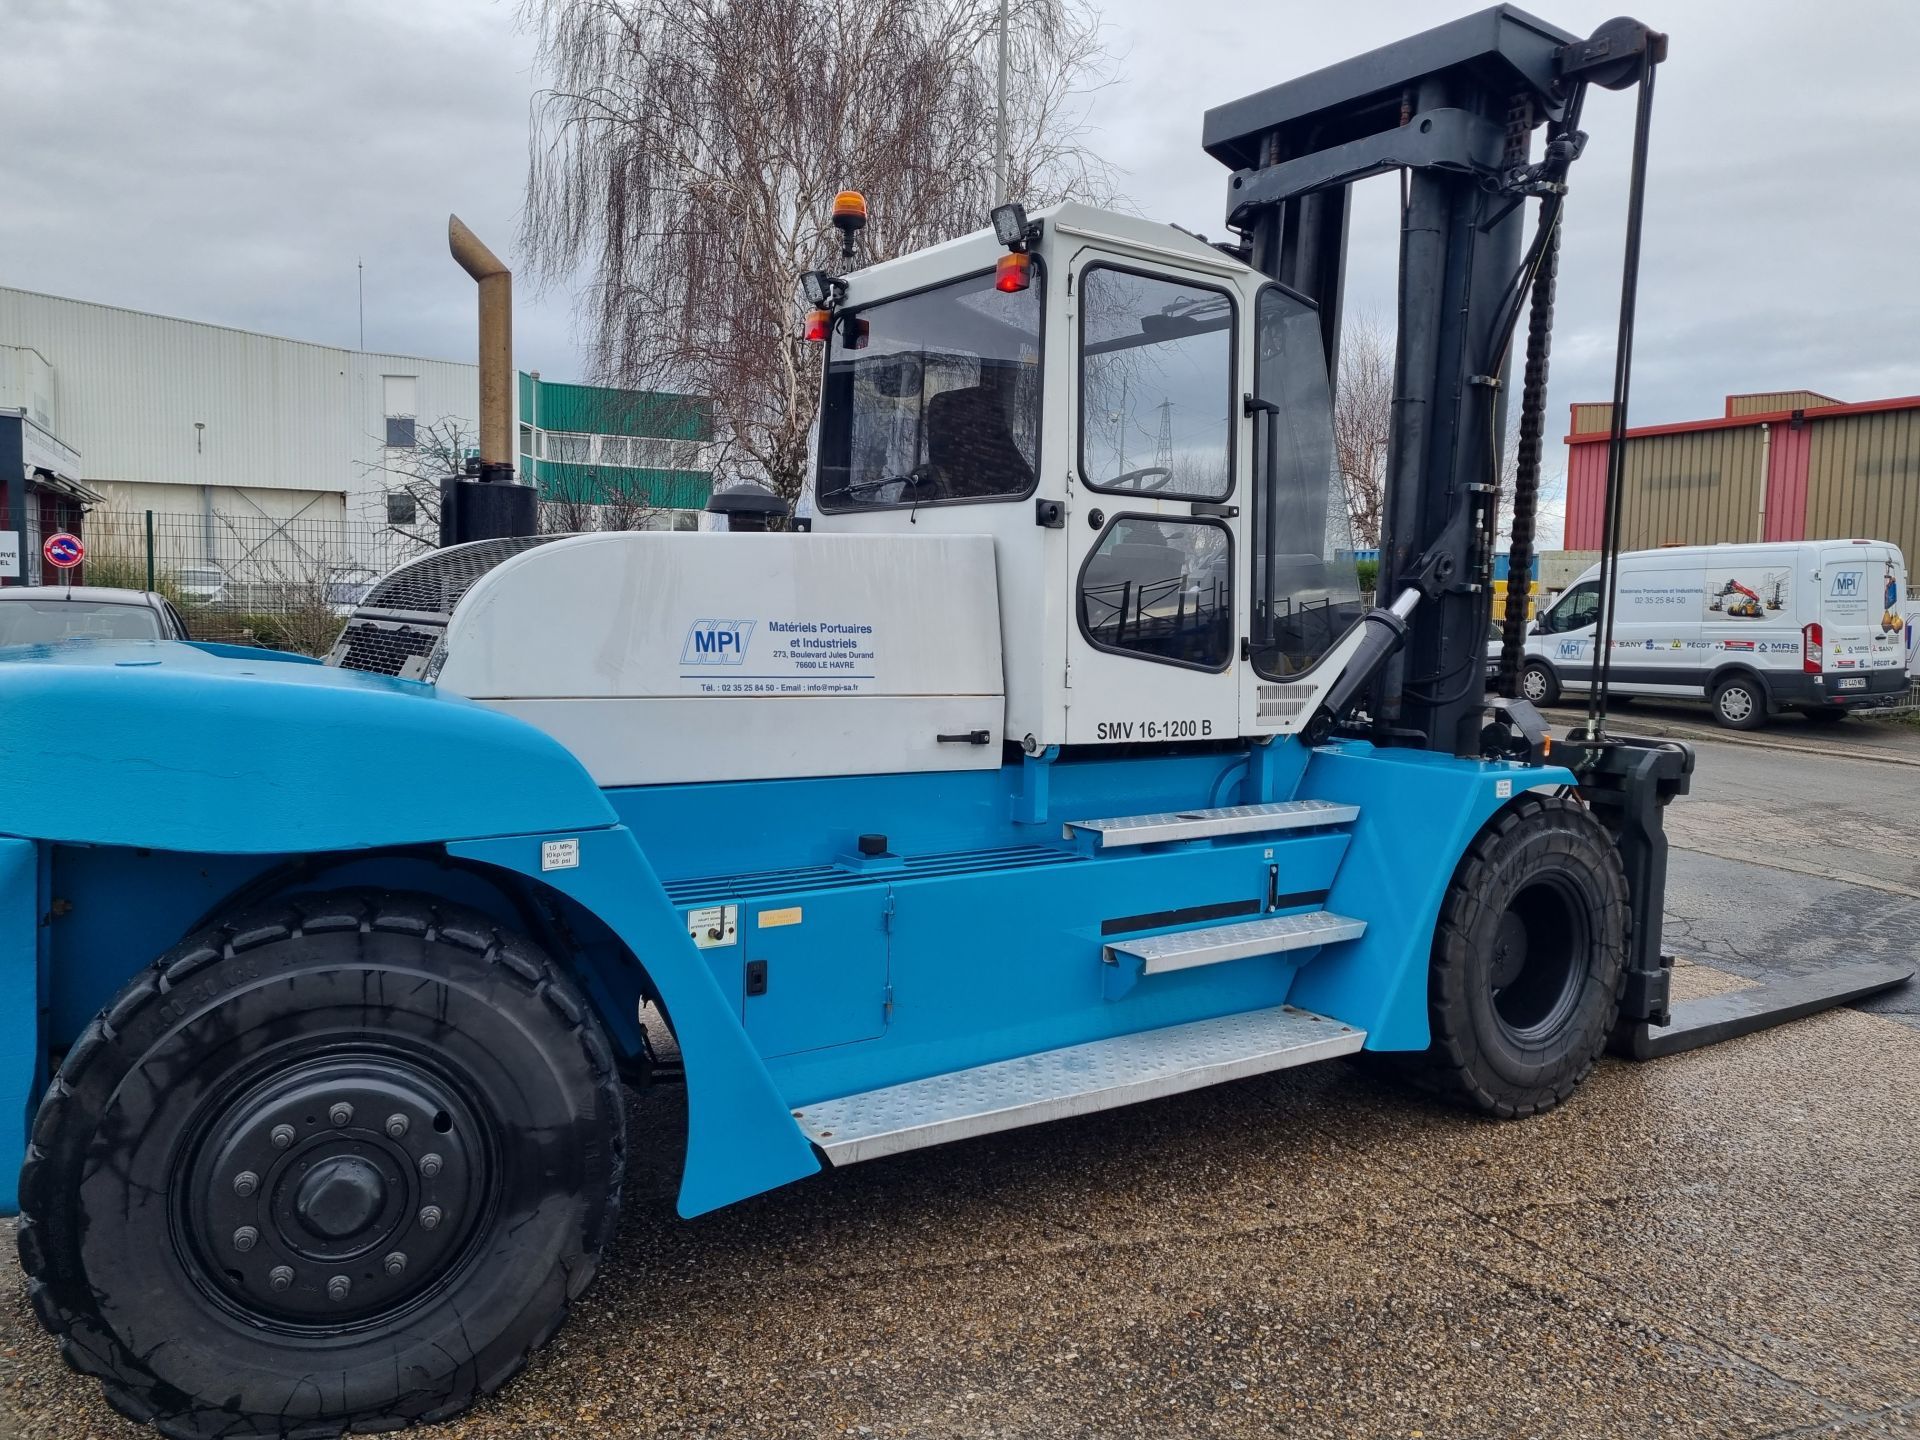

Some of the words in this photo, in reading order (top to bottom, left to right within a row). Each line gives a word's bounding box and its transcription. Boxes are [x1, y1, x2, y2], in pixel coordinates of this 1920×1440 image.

[1837, 578, 1856, 590] MPI
[1634, 596, 1643, 604] 02
[1645, 596, 1654, 604] 35
[1655, 596, 1664, 604] 25
[1665, 596, 1675, 604] 84
[1676, 596, 1686, 604] 50
[769, 621, 818, 633] Matériels
[820, 622, 873, 634] Portuaires
[695, 630, 741, 653] MPI
[790, 638, 801, 648] et
[803, 638, 857, 649] Industriels
[773, 650, 788, 659] 273,
[790, 650, 827, 659] Boulevard
[828, 651, 848, 659] Jules
[848, 651, 874, 659] Durand
[1560, 644, 1580, 655] MPI
[795, 661, 817, 669] 76600
[818, 661, 828, 669] LE
[829, 661, 855, 669] HAVRE
[721, 684, 731, 692] 02
[732, 684, 742, 692] 35
[743, 684, 753, 692] 25
[754, 684, 764, 692] 84
[765, 684, 775, 692] 50
[780, 683, 802, 692] Email
[807, 683, 859, 693] info@mpi-sa.fr
[1097, 722, 1133, 740] SMV
[1139, 720, 1197, 738] 16-1200
[1202, 719, 1212, 736] B
